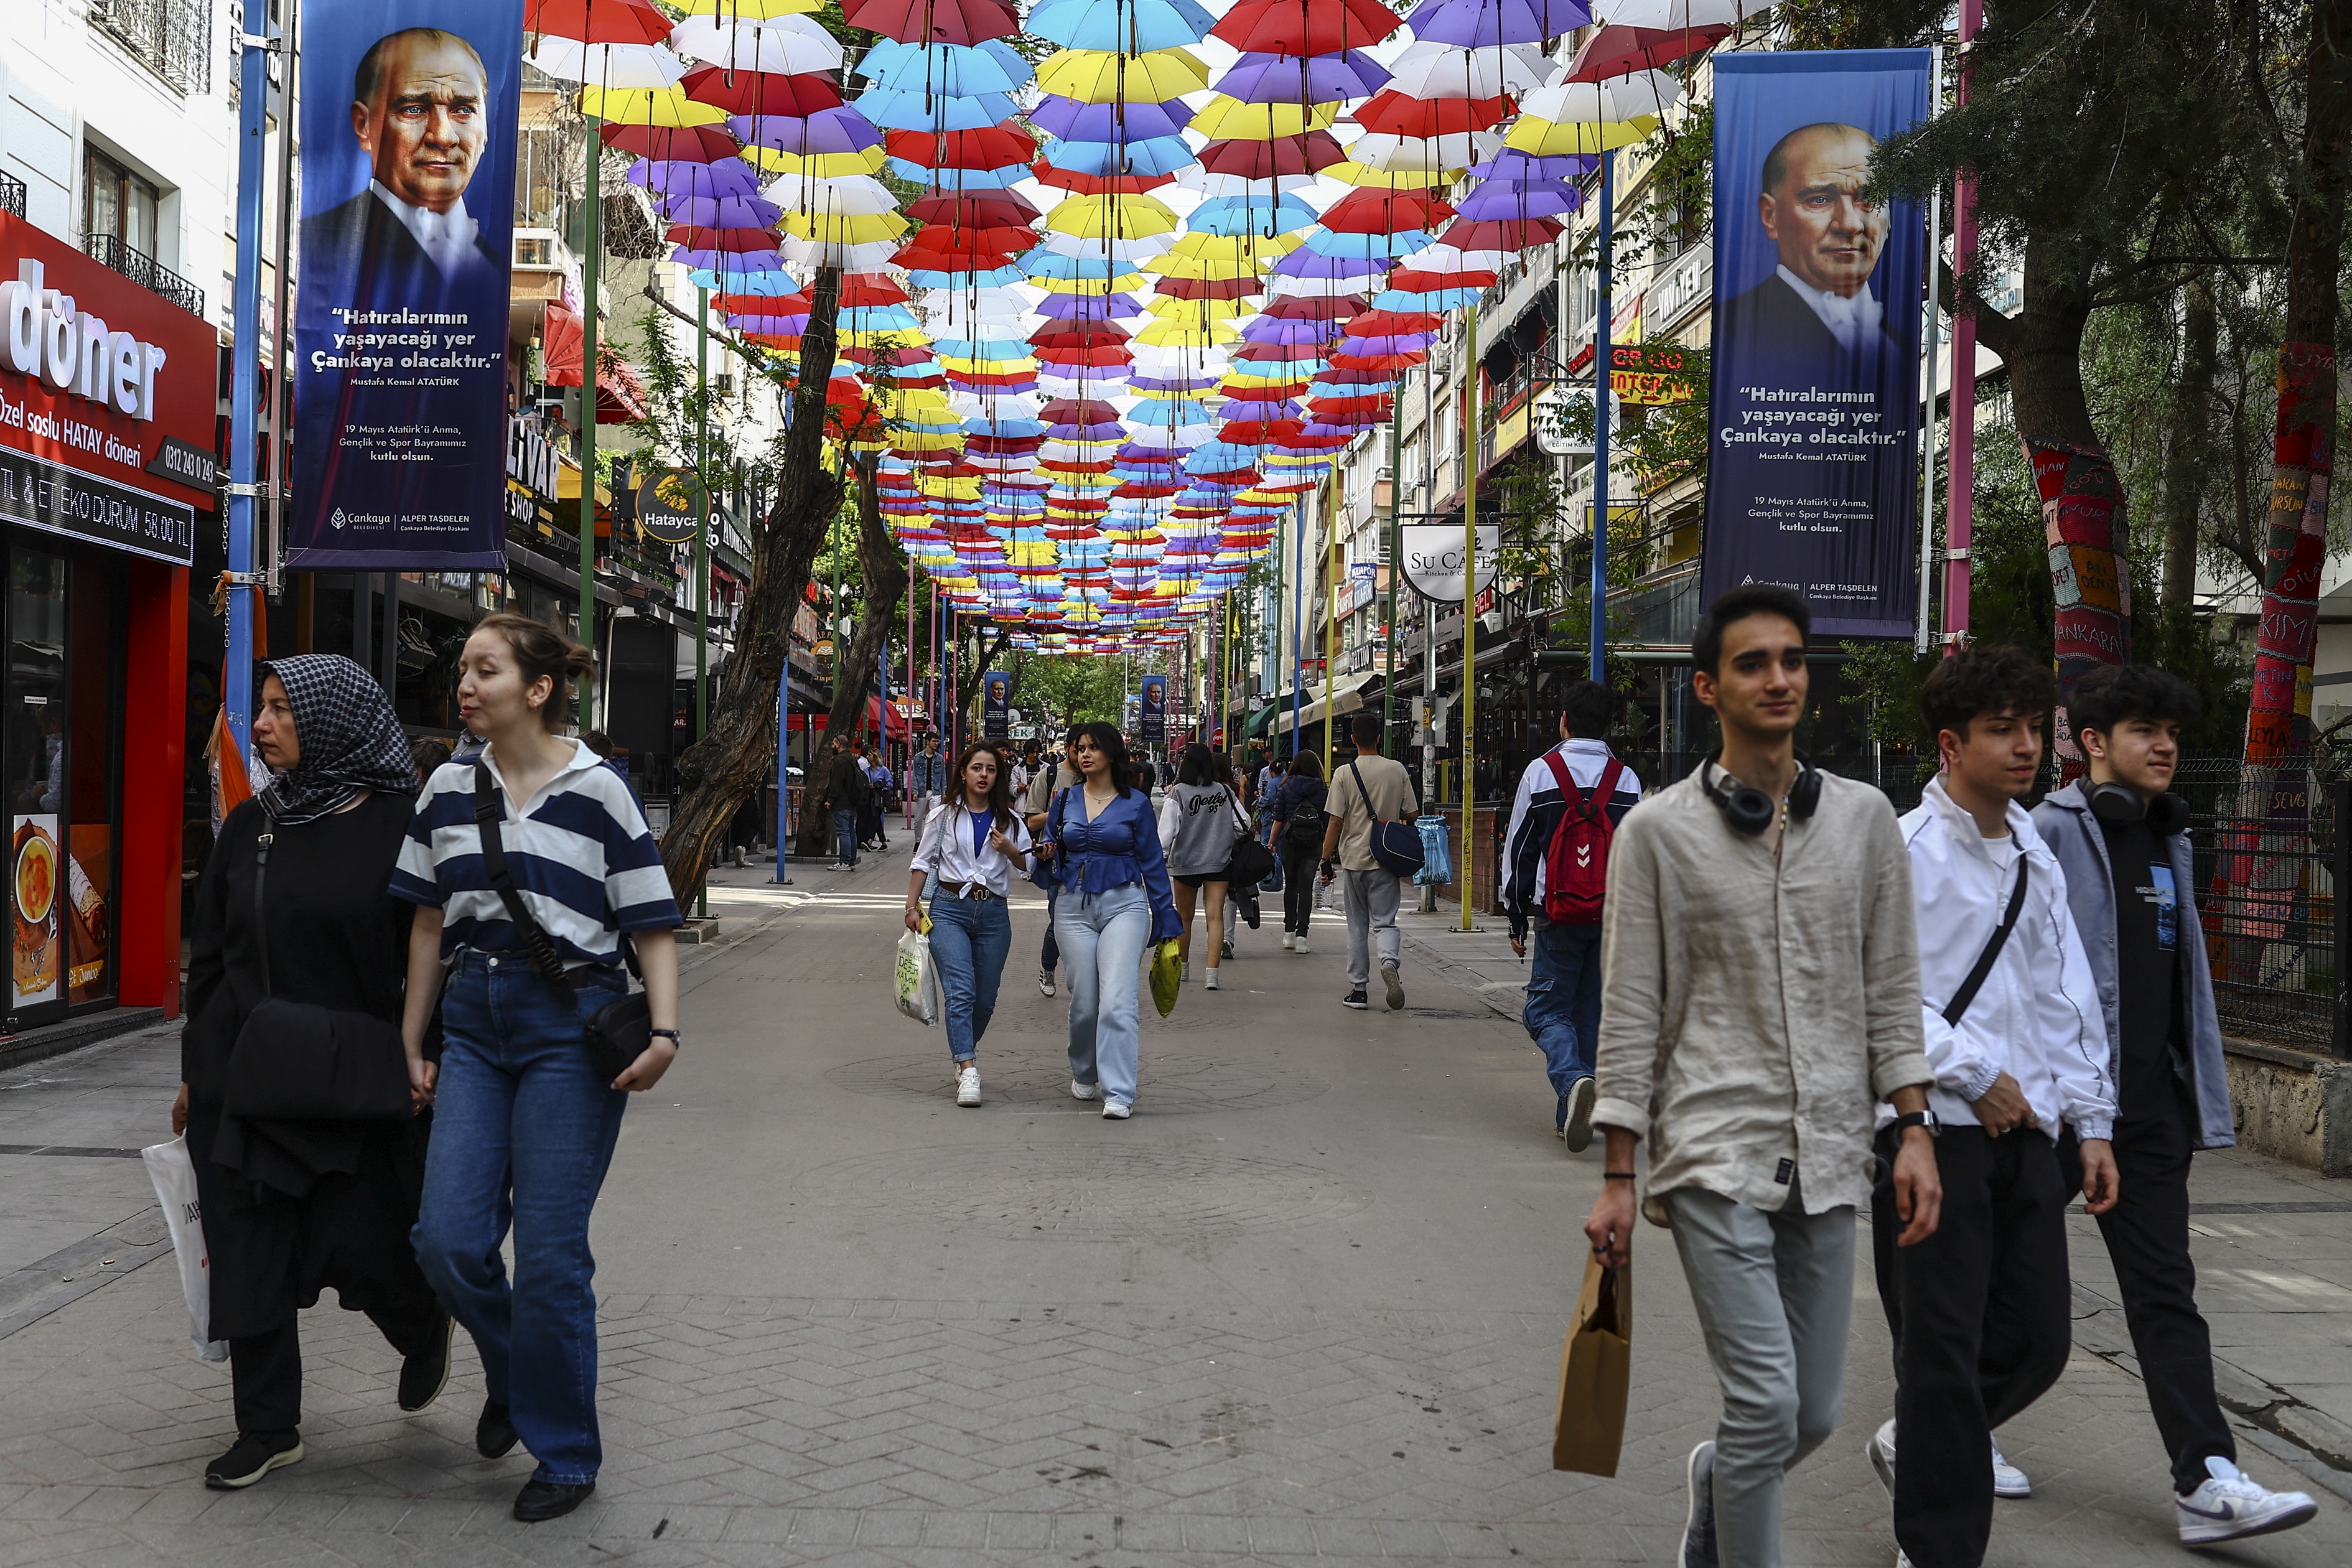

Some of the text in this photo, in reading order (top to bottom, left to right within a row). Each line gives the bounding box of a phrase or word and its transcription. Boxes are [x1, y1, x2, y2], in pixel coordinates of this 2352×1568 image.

[0, 258, 167, 422] döner
[333, 330, 476, 350] yaşayacağı yer
[311, 351, 394, 372] Çankaya
[387, 377, 414, 386] Kemal
[417, 376, 460, 386] ATATÜRK
[1742, 409, 1882, 427] yaşayacağı yer
[345, 425, 356, 434] 19
[359, 426, 385, 436] Mayıs
[432, 426, 462, 435] Anma,
[27, 411, 60, 442] soslu
[63, 418, 103, 455] HATAY
[105, 434, 141, 468] döneri
[1720, 427, 1802, 447] Çankaya
[339, 438, 373, 449] Gençlik
[390, 439, 411, 449] Spor
[414, 439, 467, 449] Bayramımız
[370, 451, 434, 461] kutlu olsun.
[1758, 452, 1867, 462] Mustafa Kemal ATATÜRK
[165, 444, 214, 484] 0312 243 0 243
[1, 468, 18, 500] TL
[93, 495, 138, 533] DÜRÜM
[176, 520, 189, 547] TL
[511, 492, 533, 525] SHOP
[1754, 497, 1765, 505] 19
[1768, 497, 1794, 507] Mayıs
[1841, 498, 1870, 508] Anma,
[348, 513, 390, 524] Çankaya
[1748, 509, 1782, 520] Gençlik
[1799, 510, 1820, 520] Spor
[1822, 511, 1874, 521] Bayramımız
[2057, 504, 2105, 521] ONUR
[428, 515, 469, 524] TAŞDELEN
[1780, 522, 1842, 533] kutlu olsun.
[1351, 564, 1376, 578] KUAFÖR
[1809, 583, 1877, 592] ALPER TAŞDELEN
[1208, 805, 1218, 813] 95
